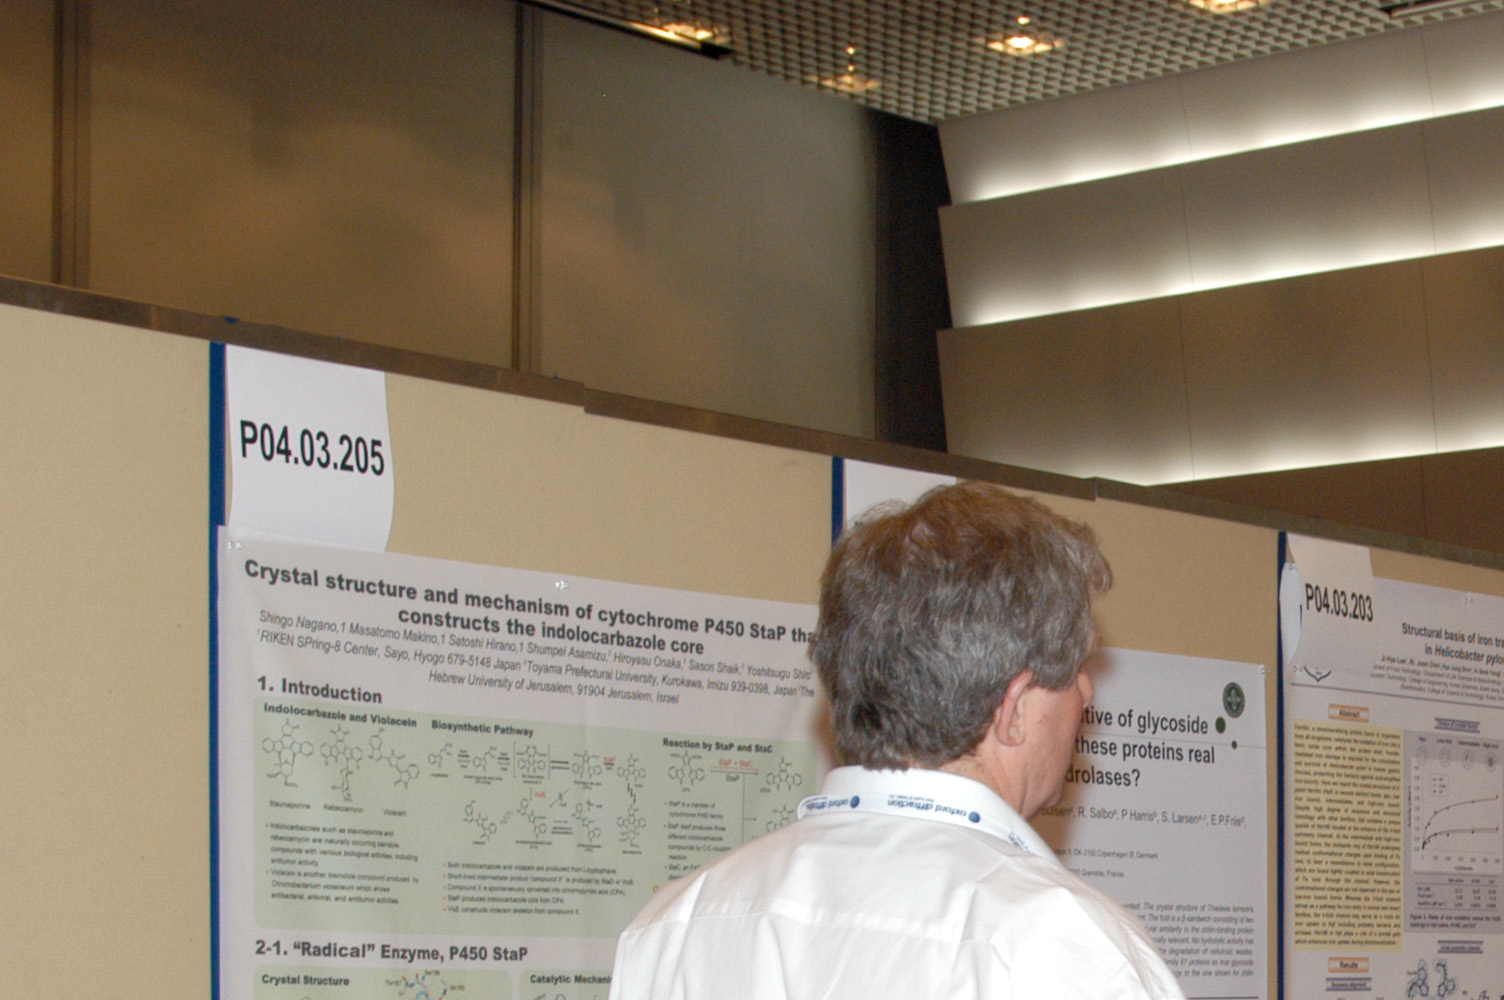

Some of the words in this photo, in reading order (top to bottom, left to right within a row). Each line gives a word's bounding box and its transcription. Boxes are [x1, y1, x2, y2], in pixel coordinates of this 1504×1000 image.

[240, 420, 385, 476] P04.03.205
[244, 559, 318, 587] Crystal
[325, 572, 417, 600] structure
[423, 587, 458, 605] and
[464, 593, 569, 618] mechanism
[575, 604, 592, 620] of
[597, 608, 698, 632] cytochrome
[704, 618, 744, 637] P450
[750, 623, 786, 642] StaP
[791, 628, 818, 645] tha
[1305, 583, 1373, 622] P04.03.203
[398, 608, 499, 633] constructs
[506, 619, 535, 638] the
[541, 623, 665, 651] indolocarbazole
[670, 639, 704, 655] core
[1402, 622, 1442, 640] Structural
[1443, 628, 1465, 643] basis
[1467, 632, 1476, 644] of
[1476, 632, 1493, 646] iron
[1425, 642, 1432, 656] in
[1434, 644, 1484, 662] Helicobacter
[256, 676, 273, 692] 1.
[281, 679, 382, 704] Introduction
[264, 704, 346, 720] Indolocarbazole
[348, 712, 367, 722] and
[370, 713, 418, 727] Violacein
[1118, 709, 1134, 728] of
[1137, 711, 1209, 735] glycoside
[432, 720, 490, 734] Biosynthetic
[493, 725, 534, 739] Pathway
[662, 738, 700, 750] Reaction
[701, 740, 712, 753] by
[714, 741, 734, 752] StaP
[736, 742, 752, 753] and
[754, 743, 772, 754] StaC
[1075, 736, 1117, 756] these
[1122, 742, 1184, 762] proteins
[1189, 746, 1215, 764] real
[1065, 765, 1141, 787] drolases?
[255, 941, 288, 956] 2-1.
[293, 942, 375, 958] “Radical”
[380, 944, 445, 962] Enzyme,
[449, 946, 488, 961] P450
[493, 946, 528, 961] StaP
[262, 974, 300, 986] Crystal
[303, 975, 350, 986] Structure
[573, 974, 612, 984] Mechani
